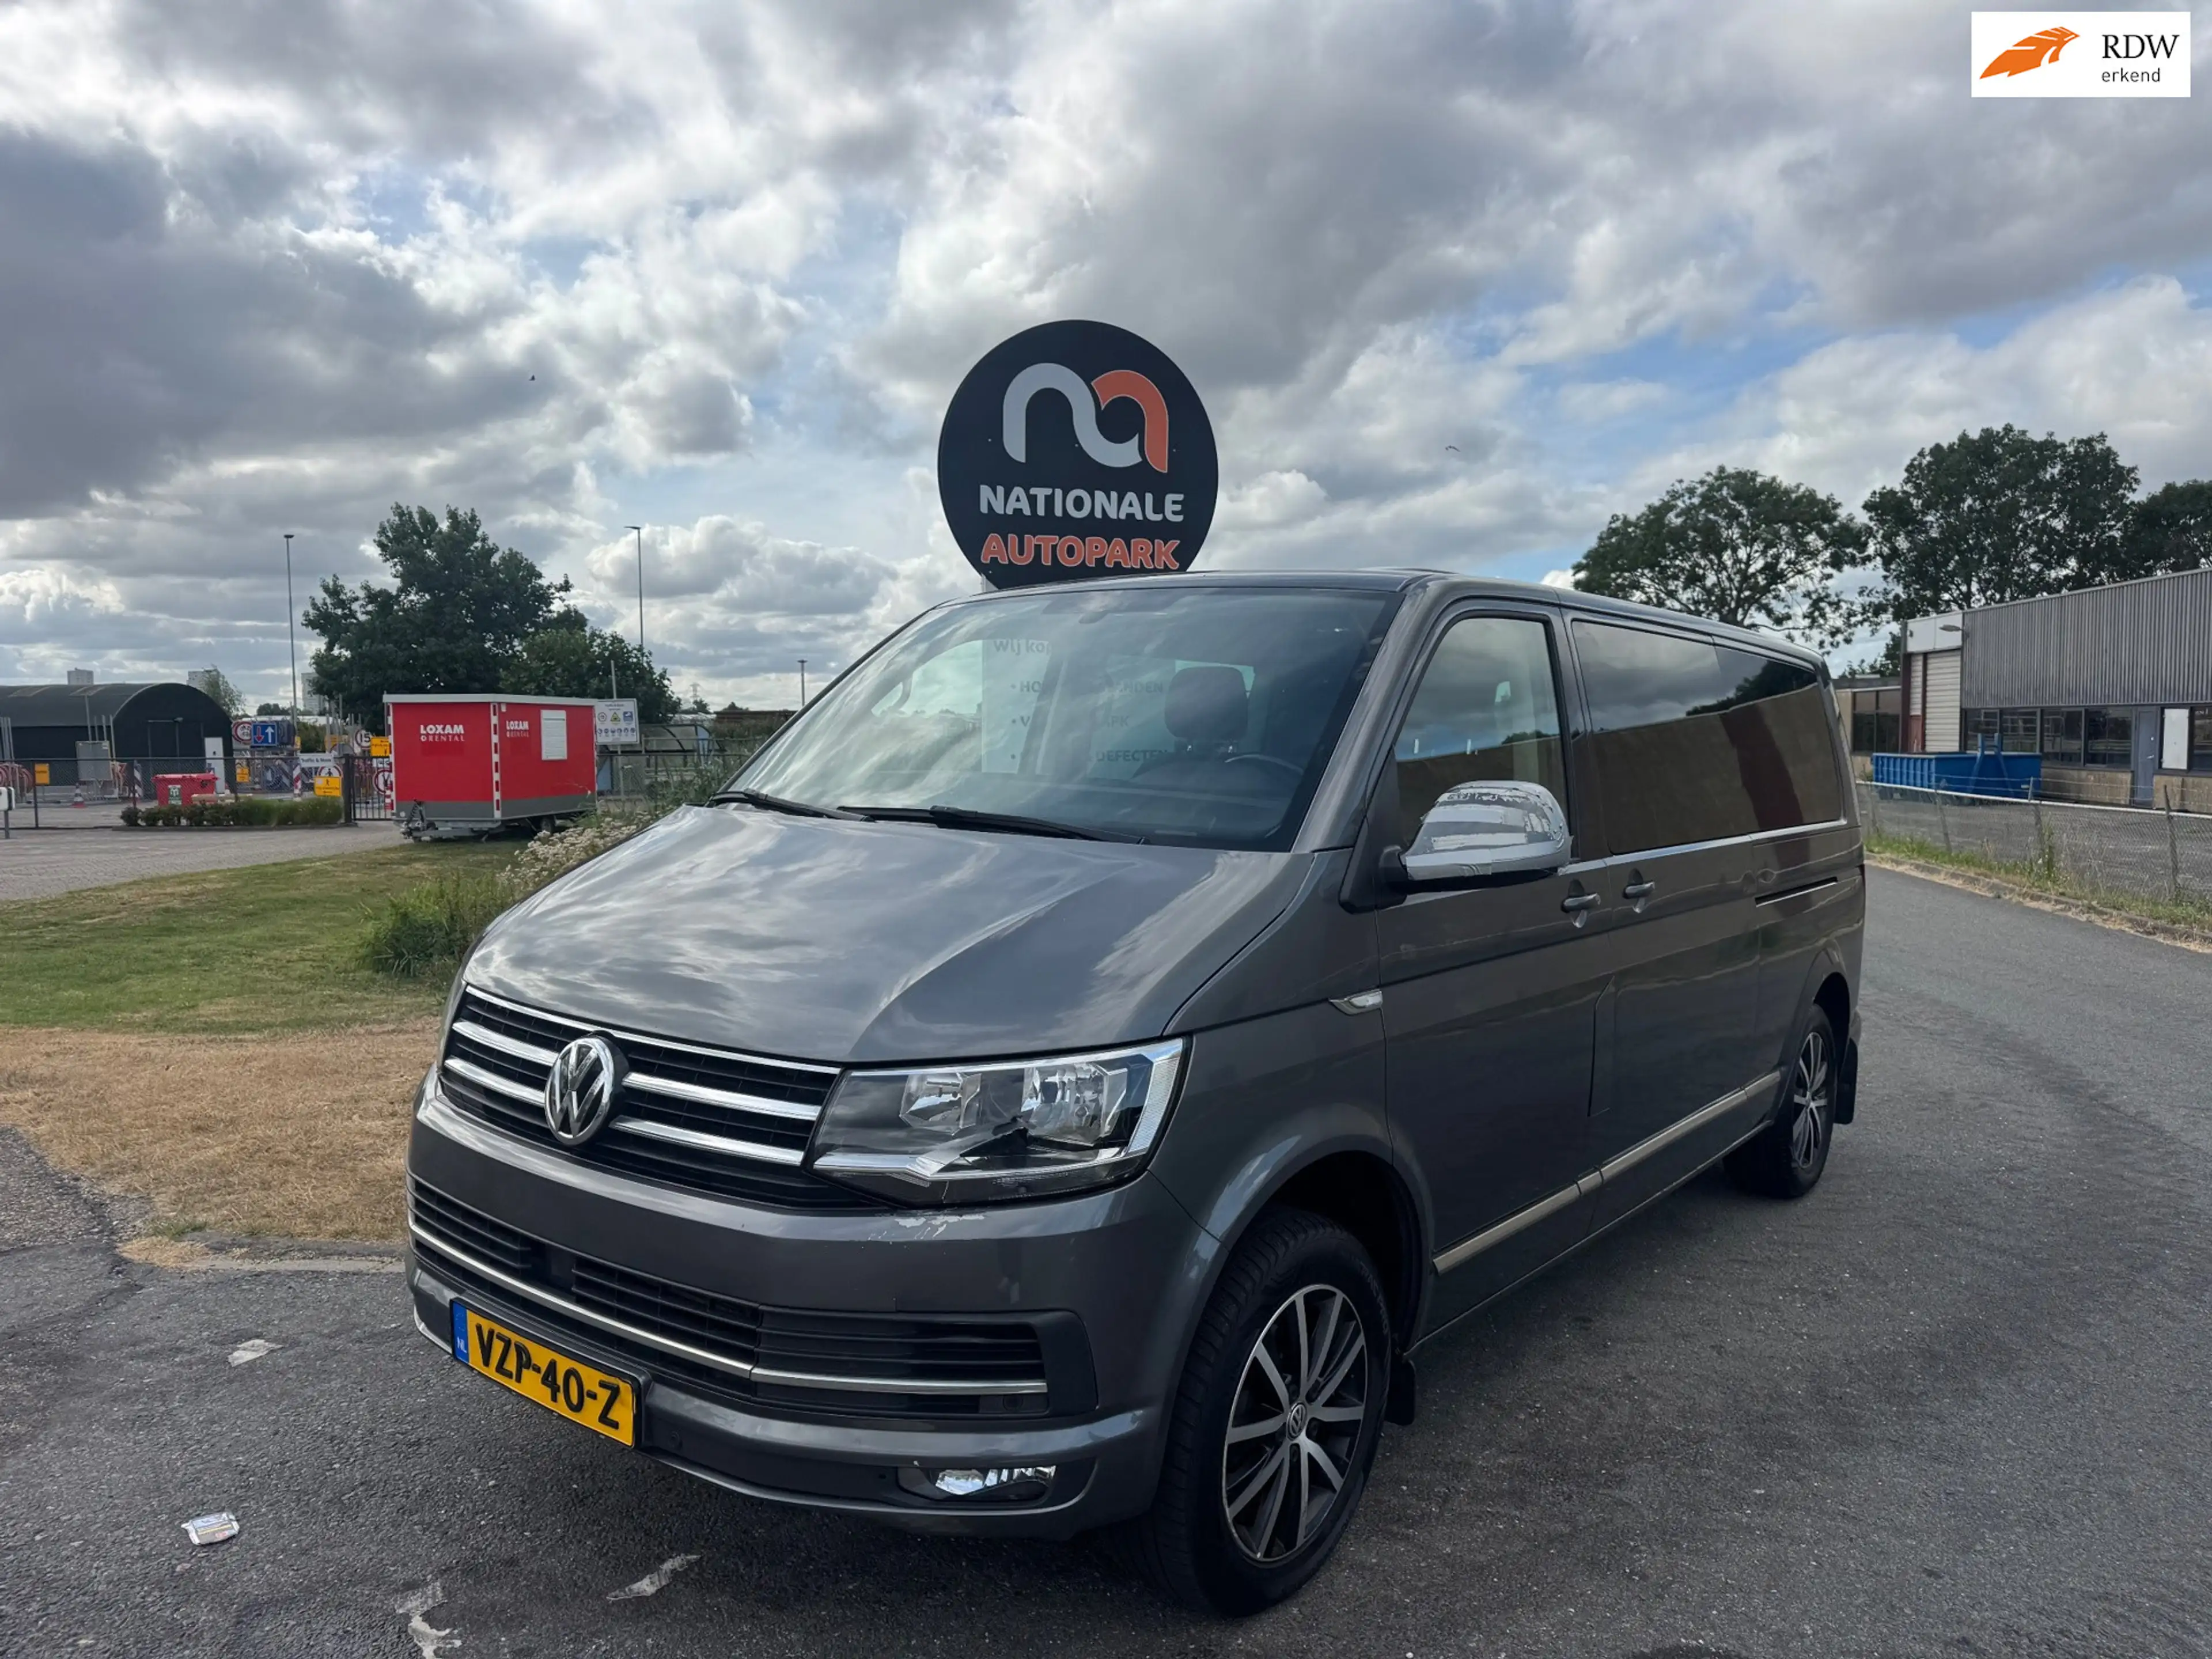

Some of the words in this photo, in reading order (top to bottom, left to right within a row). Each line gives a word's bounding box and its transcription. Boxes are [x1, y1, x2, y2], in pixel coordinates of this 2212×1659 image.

[980, 484, 1184, 522] NATIONALE
[981, 533, 1180, 570] AUTOPARK
[420, 724, 464, 734] LOXAM
[506, 721, 529, 730] LOXAM
[1096, 749, 1168, 762] DEFECTE
[456, 1336, 467, 1353] NL
[475, 1322, 621, 1430] VZP-40-Z
